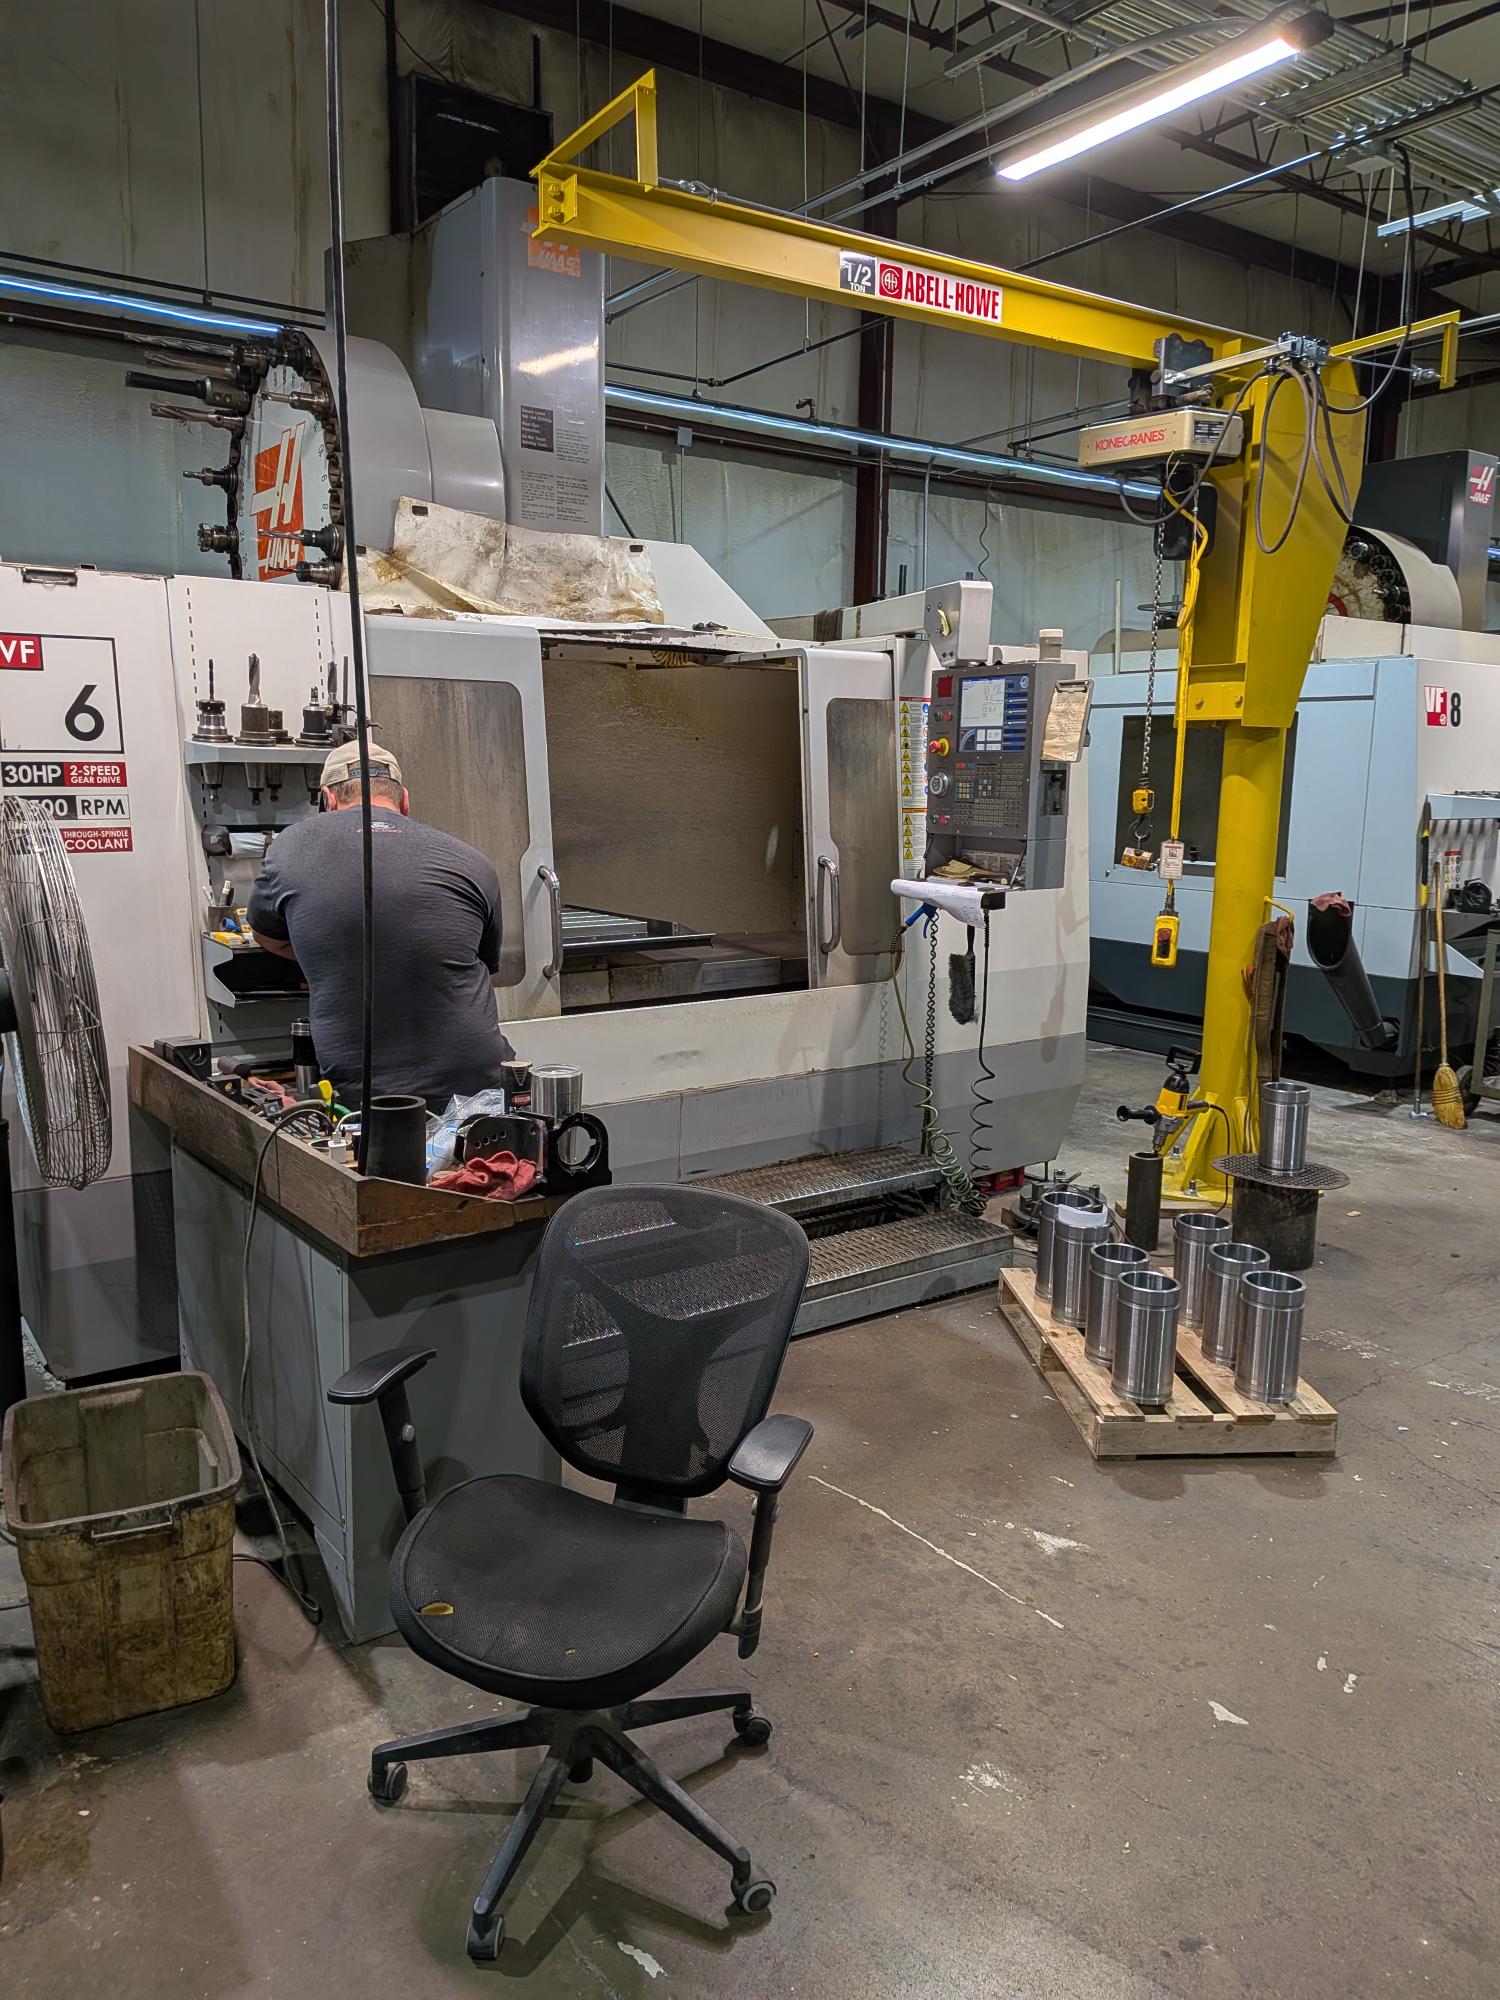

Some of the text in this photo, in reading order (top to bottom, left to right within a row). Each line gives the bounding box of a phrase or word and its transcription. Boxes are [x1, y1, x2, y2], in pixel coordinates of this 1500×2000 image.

[845, 262, 872, 287] 1/2
[850, 282, 866, 293] TON
[903, 270, 1000, 320] ABELL-HOWE
[1095, 427, 1166, 452] KONECRANES
[0, 639, 35, 664] VF
[1424, 686, 1445, 713] VF
[1450, 691, 1462, 728] 8
[64, 684, 105, 742] 6
[4, 764, 62, 784] 30HP
[69, 764, 121, 777] 2-SPEED
[70, 776, 95, 784] GEAR
[96, 776, 122, 784] DRIVE
[80, 798, 126, 816] RPM
[63, 829, 129, 839] THROUGH-SPINDLE
[64, 838, 129, 851] COOLANT
